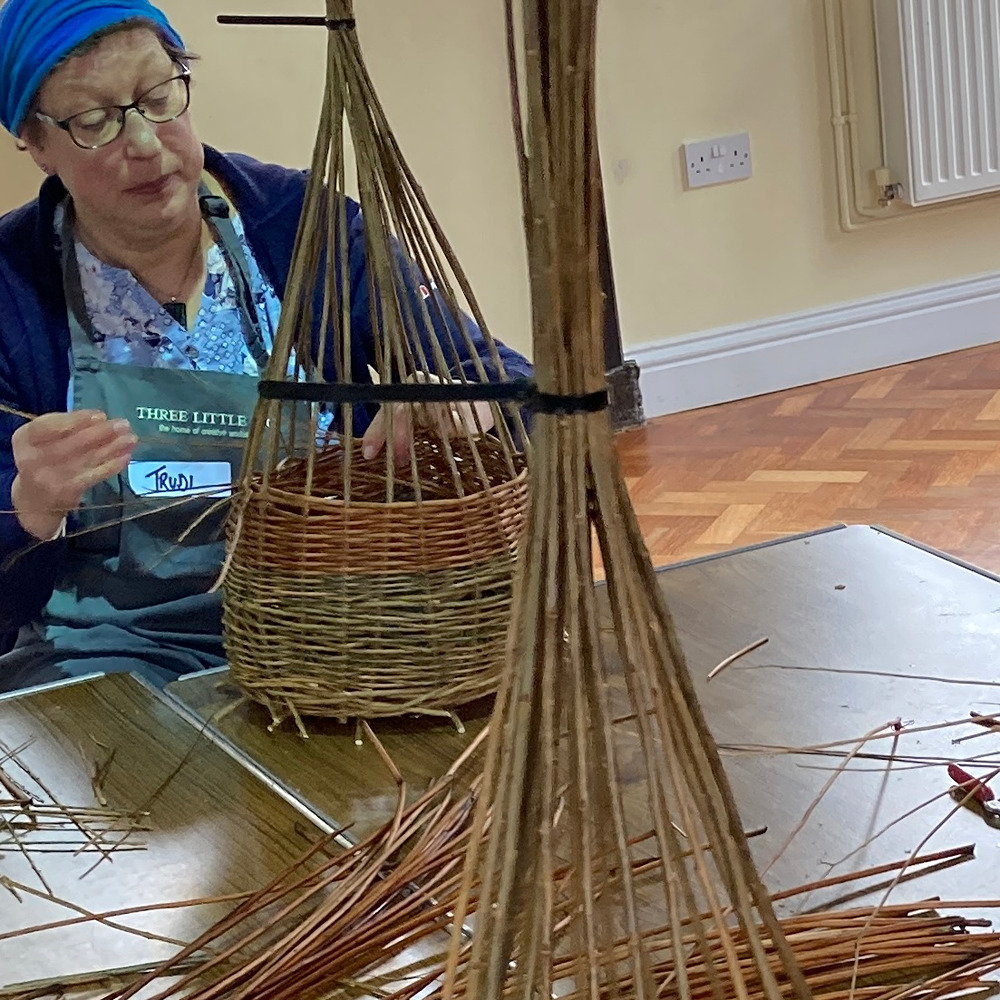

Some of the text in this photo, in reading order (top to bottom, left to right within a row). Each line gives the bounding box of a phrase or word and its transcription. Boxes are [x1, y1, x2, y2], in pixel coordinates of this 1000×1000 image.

[136, 406, 188, 423] THREE
[193, 411, 247, 427] LITTLE
[145, 464, 194, 491] TRUDI
